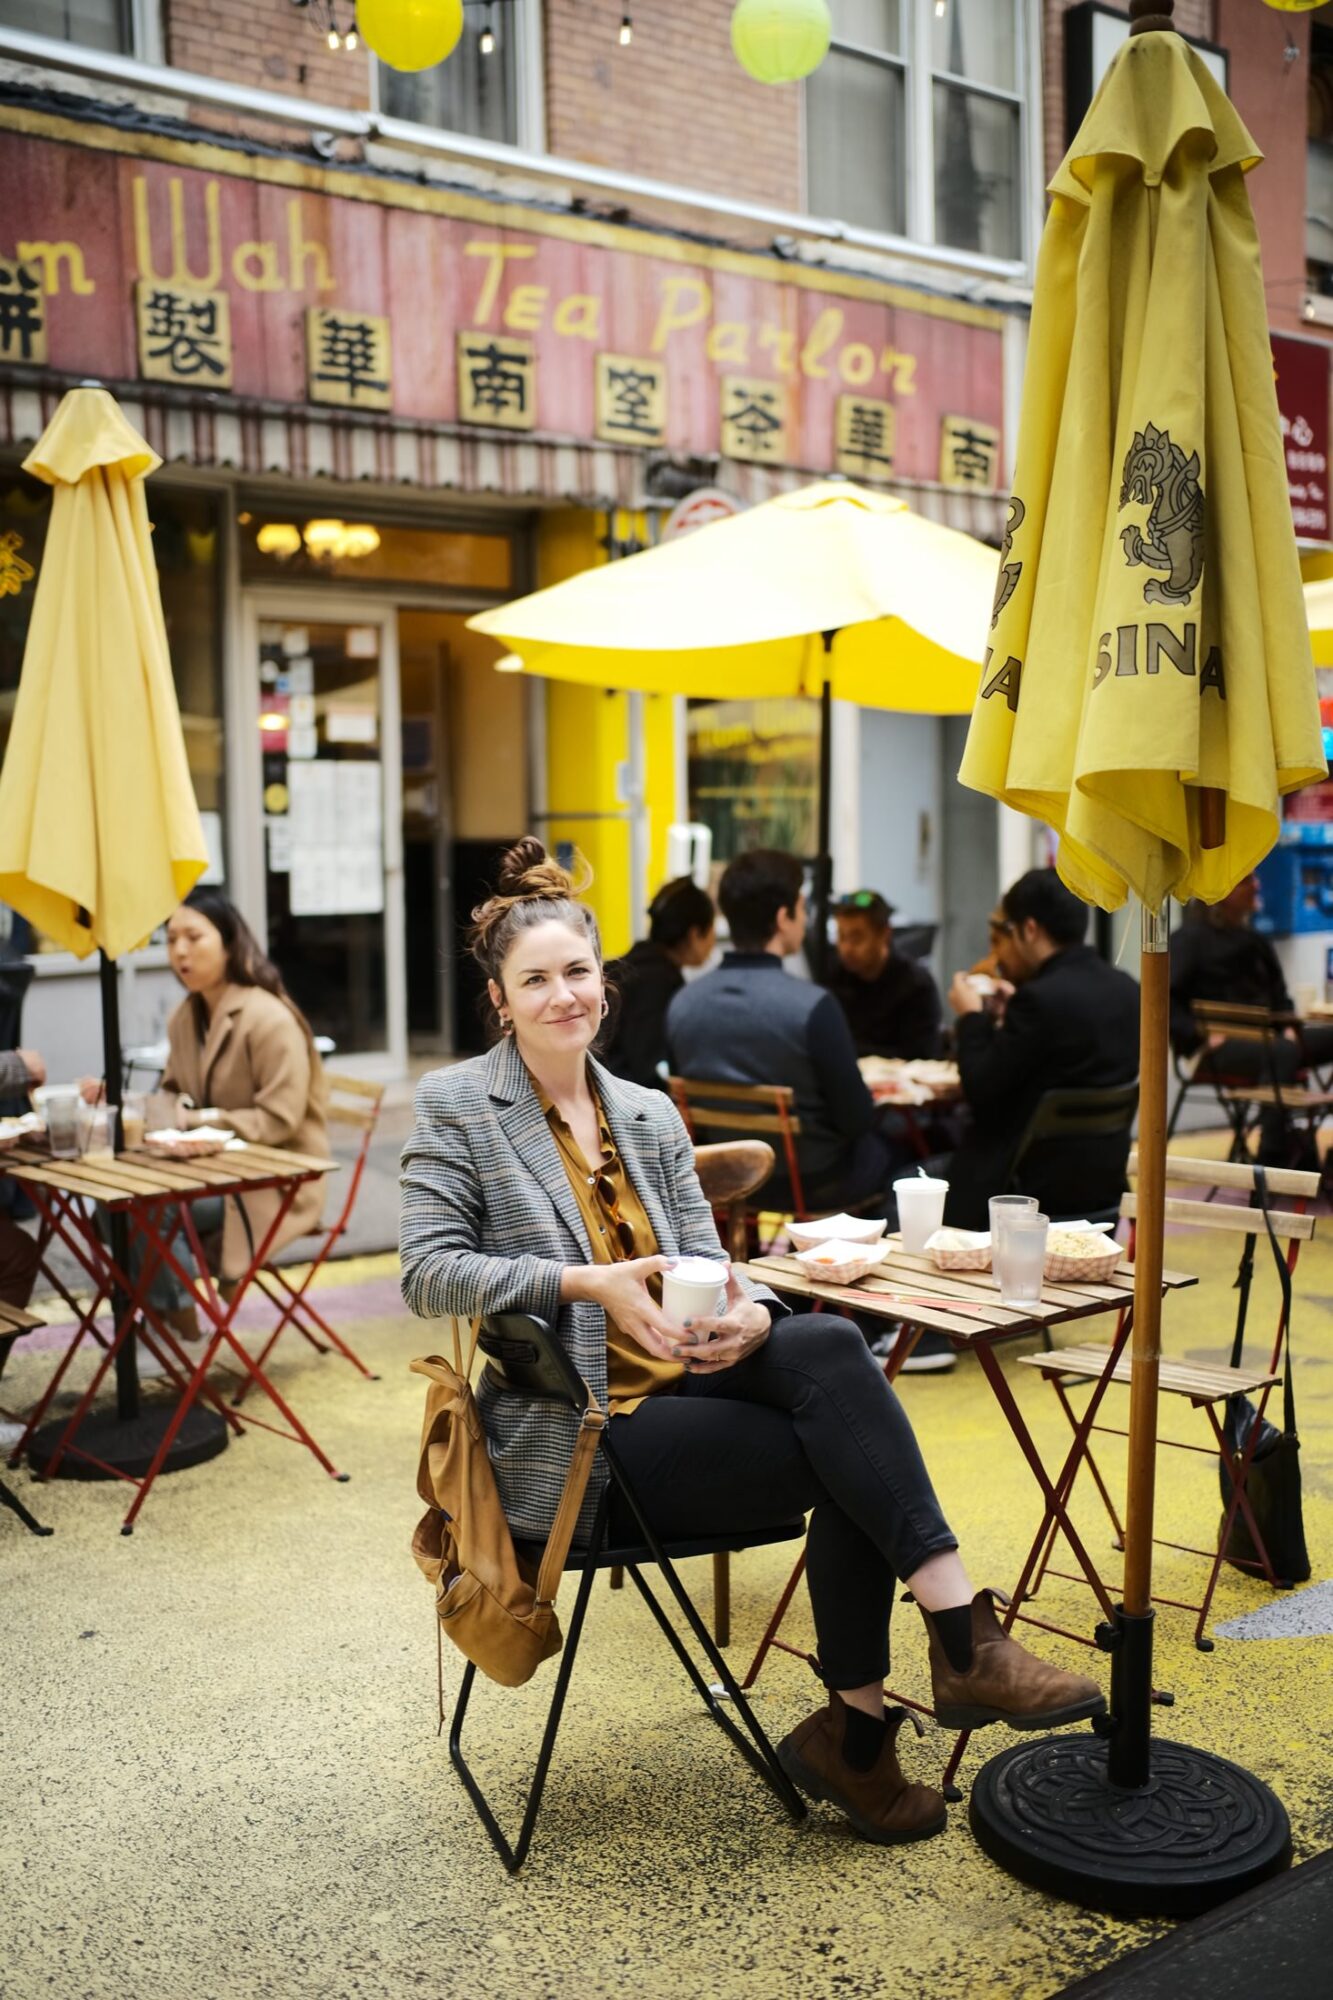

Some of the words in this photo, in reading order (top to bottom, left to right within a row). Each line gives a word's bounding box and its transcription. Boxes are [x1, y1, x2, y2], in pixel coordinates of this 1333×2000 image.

[133, 175, 336, 292] Wah
[463, 241, 600, 340] Tea
[648, 277, 918, 394] Parlor
